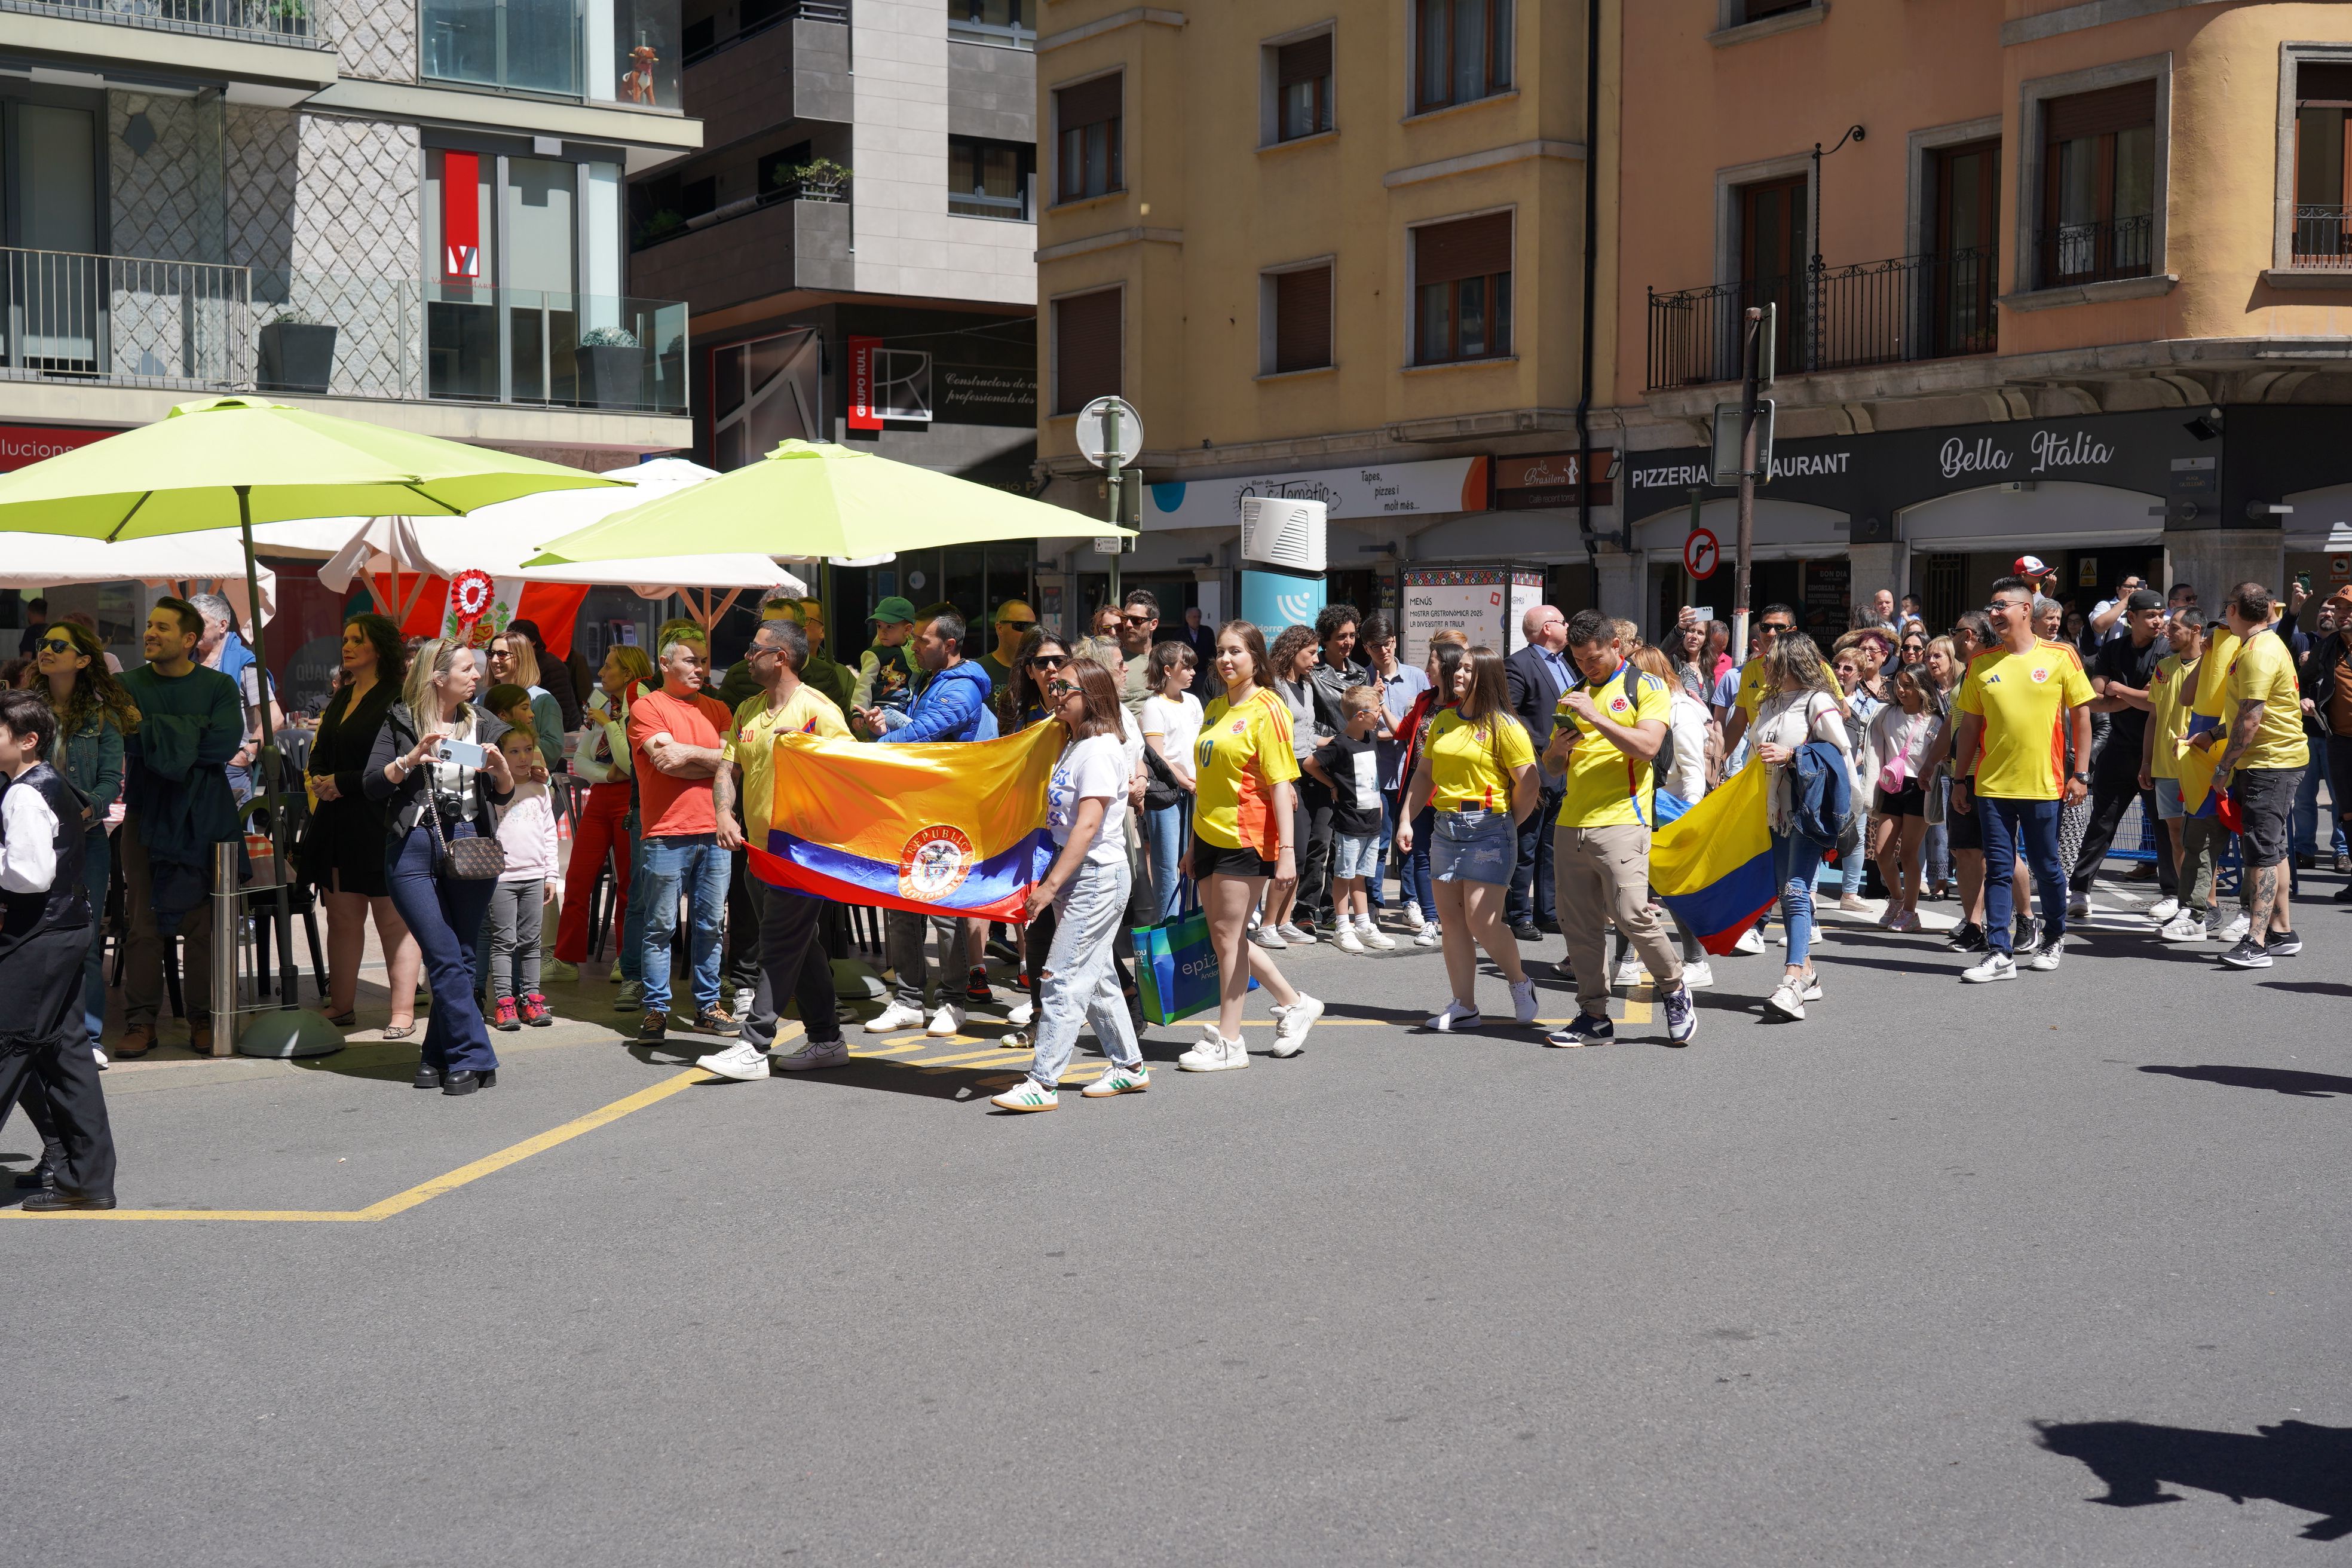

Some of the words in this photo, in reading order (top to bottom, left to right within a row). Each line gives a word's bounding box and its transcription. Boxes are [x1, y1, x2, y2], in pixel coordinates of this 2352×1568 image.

[857, 347, 866, 375] RULL
[945, 372, 1010, 388] Constructors
[1012, 378, 1026, 388] de
[856, 377, 866, 417] GRUPO
[945, 389, 1016, 405] professionals
[1940, 437, 2014, 479] Bella
[2031, 430, 2115, 474] Italia
[1537, 460, 1549, 474] La
[1632, 464, 1709, 489] PIZZERIA
[1770, 452, 1851, 478] AURANT
[1361, 470, 1383, 485] Tapes,
[1524, 467, 1566, 486] Brasilera
[1375, 486, 1396, 500] pizzes
[1384, 499, 1399, 512] molt
[1410, 596, 1432, 606] MENÚS
[1258, 624, 1284, 633] dorra
[296, 664, 331, 682] QUAL
[742, 730, 754, 743] 10
[1199, 740, 1214, 768] 10
